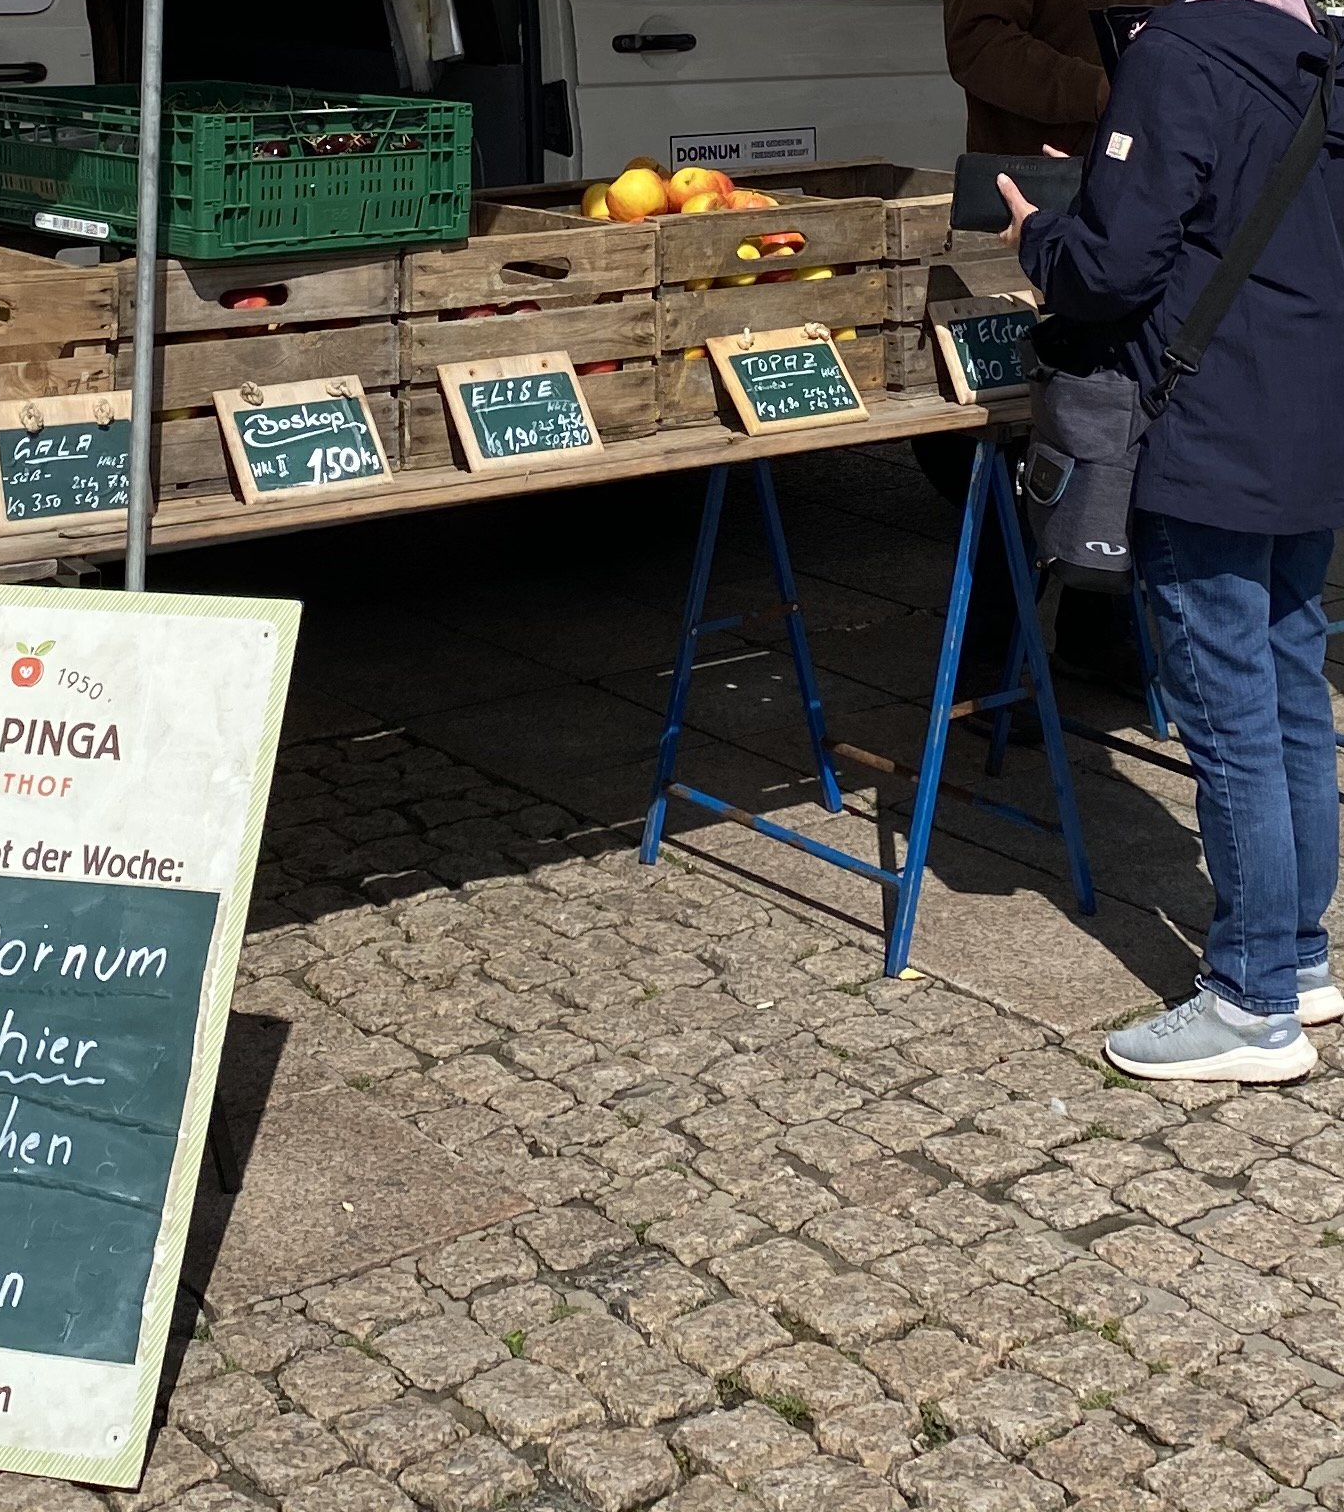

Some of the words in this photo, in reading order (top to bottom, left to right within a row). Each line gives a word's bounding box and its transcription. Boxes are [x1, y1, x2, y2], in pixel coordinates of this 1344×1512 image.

[676, 143, 741, 163] DORNUM
[740, 351, 818, 376] TOPAZ
[244, 405, 345, 435] Boskop
[13, 433, 93, 461] GALA
[306, 445, 360, 484] 1,50
[56, 666, 105, 701] 1950
[22, 838, 72, 875] der
[82, 844, 186, 884] Woche:
